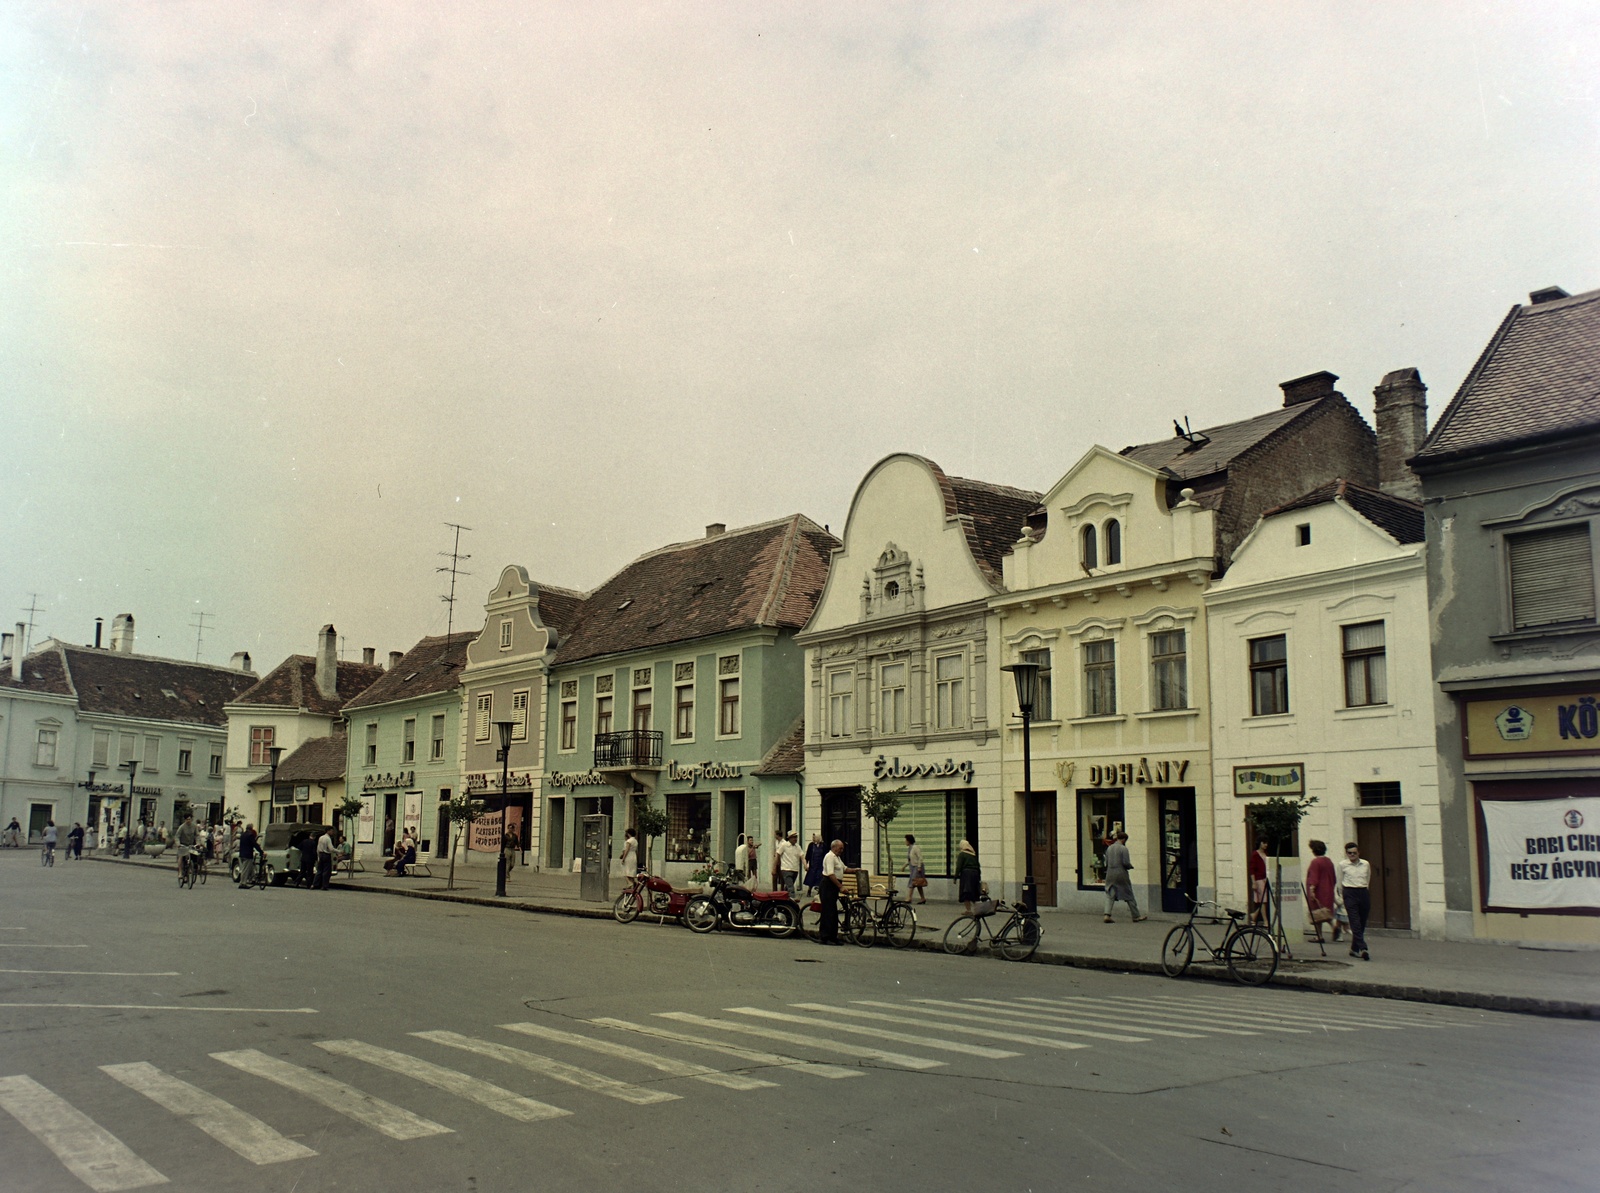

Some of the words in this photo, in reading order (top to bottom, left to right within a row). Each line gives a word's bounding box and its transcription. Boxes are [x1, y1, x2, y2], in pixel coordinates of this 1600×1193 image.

[1558, 696, 1600, 739] KÖ
[874, 755, 974, 783] Édesség
[1089, 757, 1190, 786] DOHÁNY
[1526, 836, 1564, 855] BABI
[1511, 858, 1549, 880] KÉSZ
